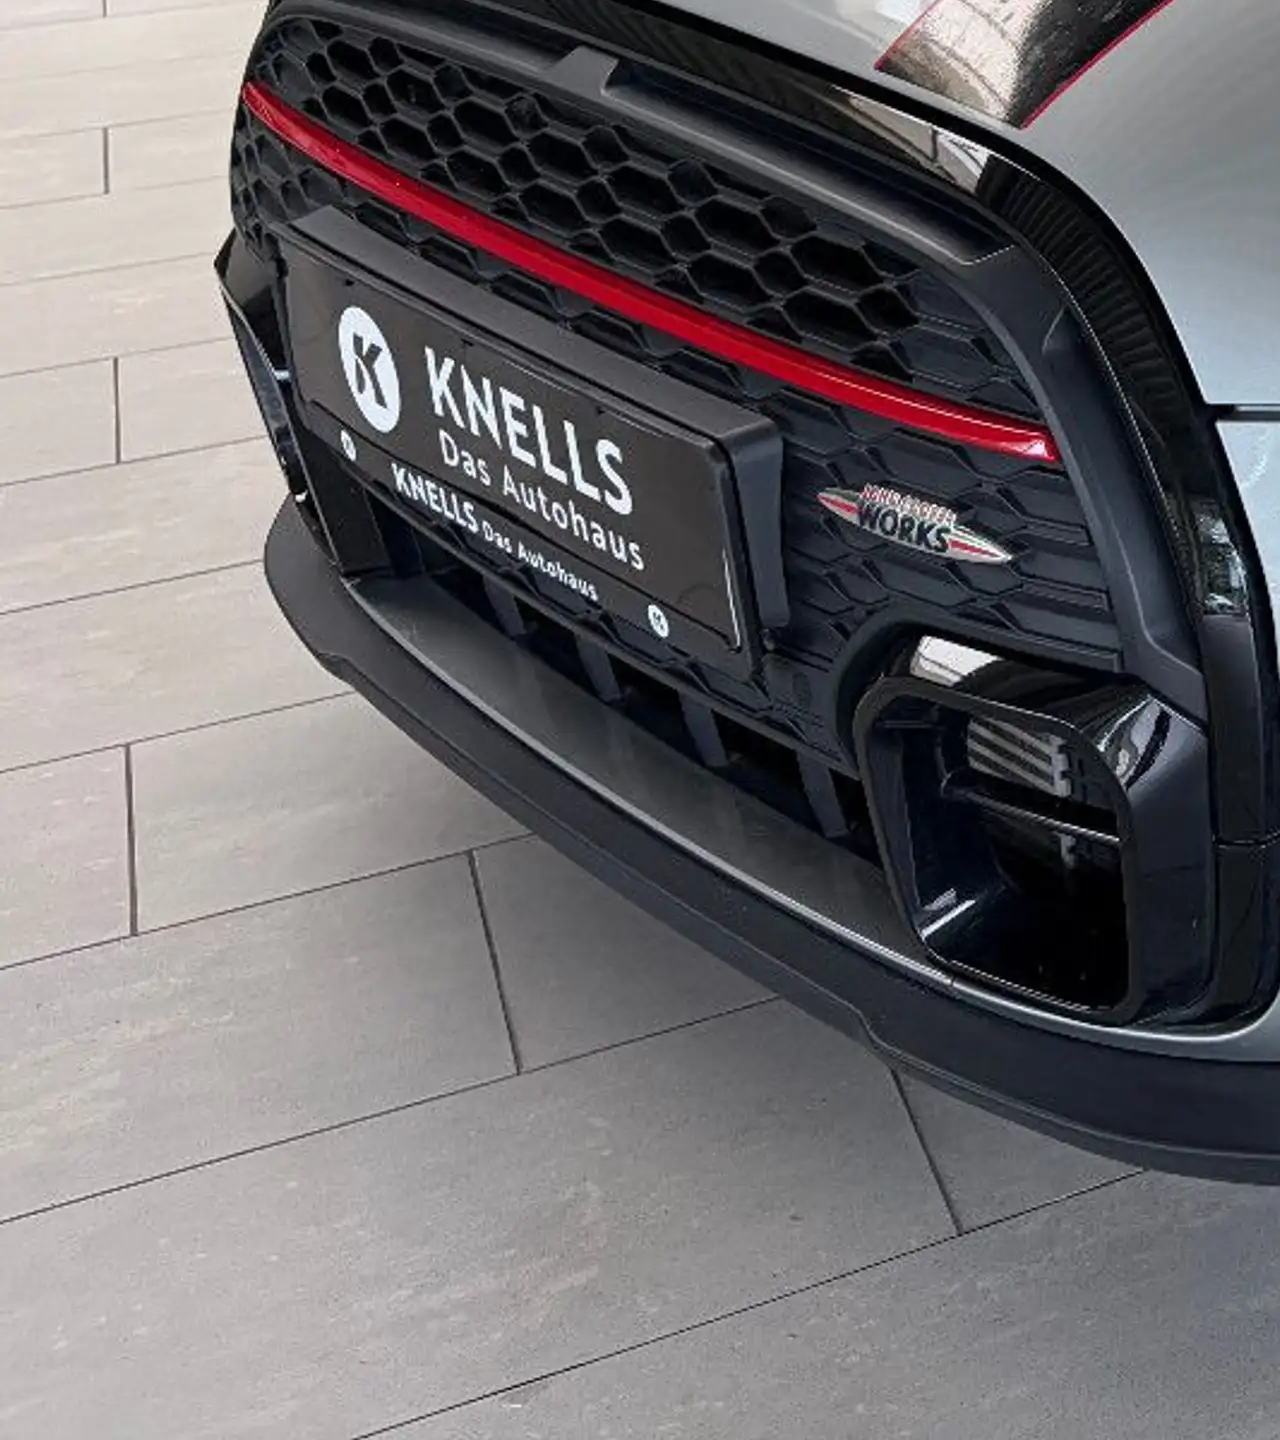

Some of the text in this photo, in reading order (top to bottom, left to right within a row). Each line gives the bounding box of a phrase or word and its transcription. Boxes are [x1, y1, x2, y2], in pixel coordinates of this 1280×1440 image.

[424, 345, 633, 516] KNELLS
[439, 428, 645, 571] Das Autohaus
[391, 462, 599, 602] KNELLS Das Autohaus
[858, 501, 951, 553] WORKS
